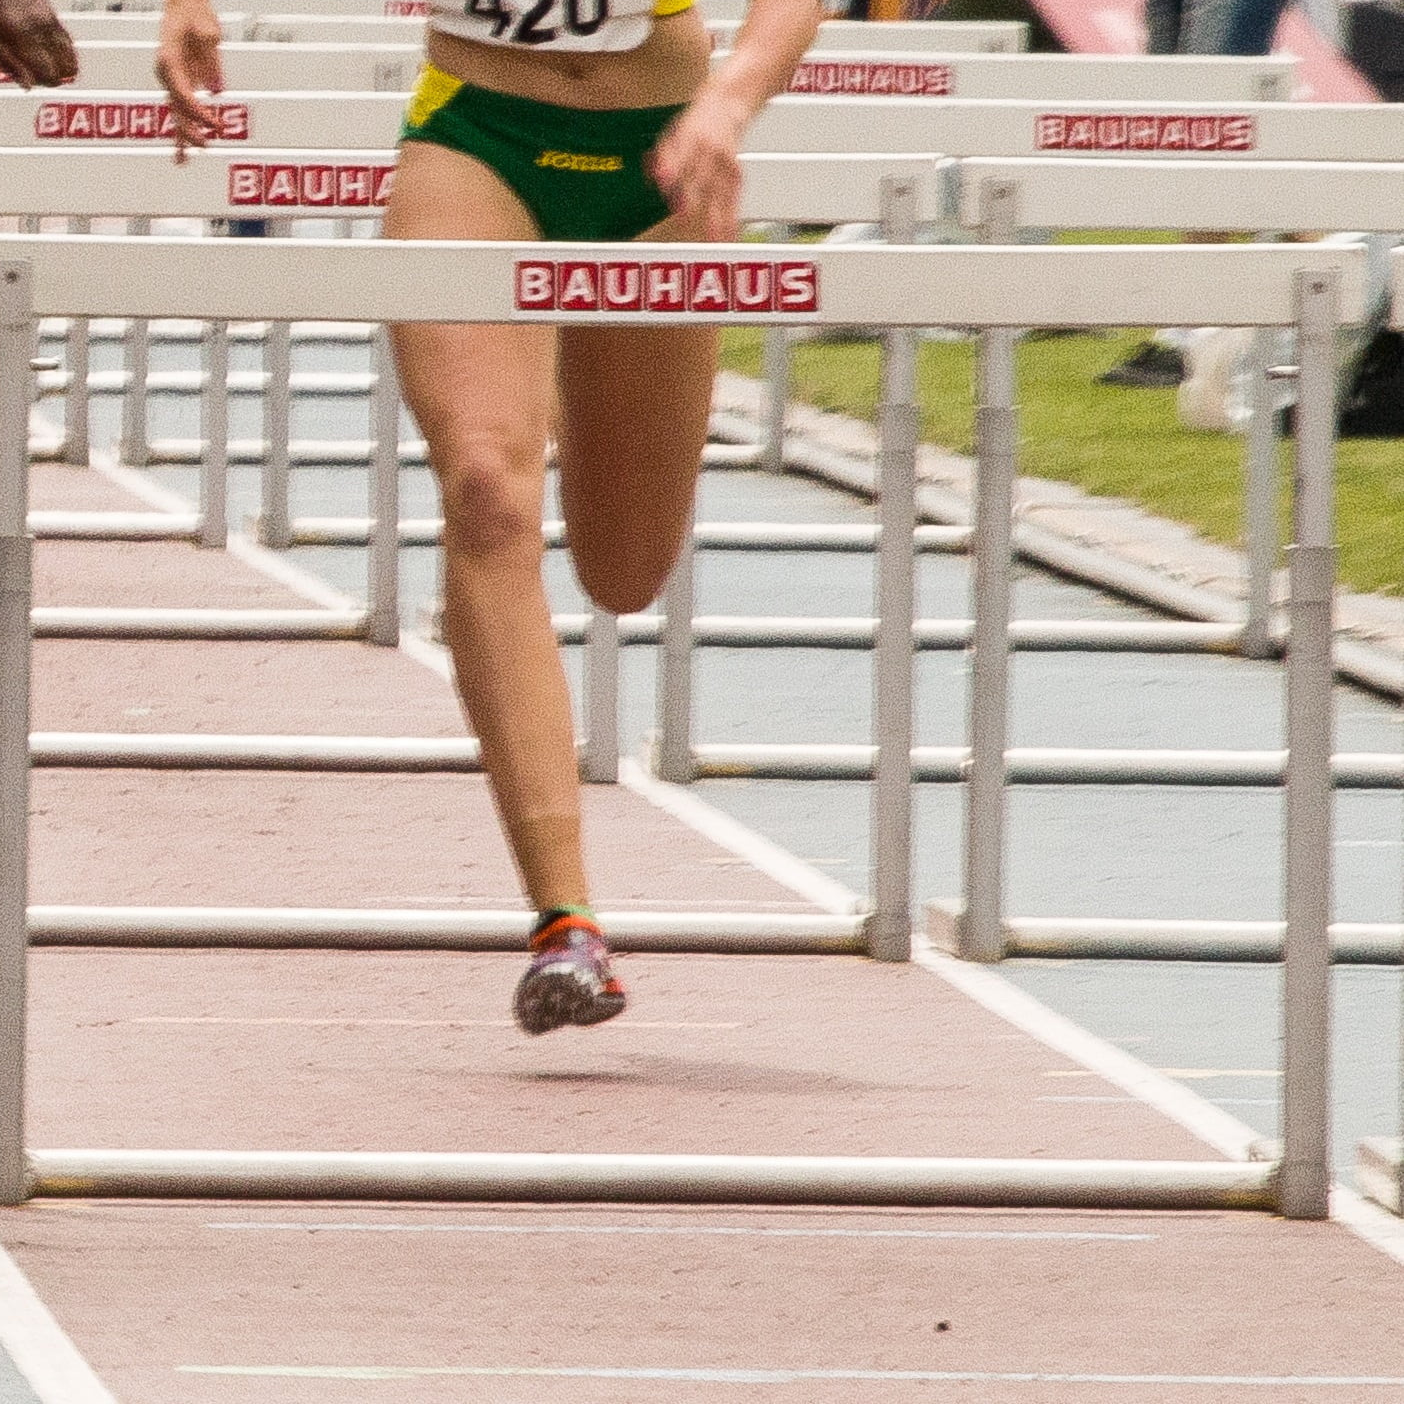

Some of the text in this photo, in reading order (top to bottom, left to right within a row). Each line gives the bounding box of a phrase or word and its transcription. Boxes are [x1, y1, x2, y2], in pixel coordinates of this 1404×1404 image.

[791, 64, 952, 94] AUHAUS
[37, 104, 248, 138] BAUHAS
[1036, 116, 1254, 151] BAUHAUS
[230, 165, 392, 205] BAUHA
[517, 263, 819, 312] BAUHAUS
